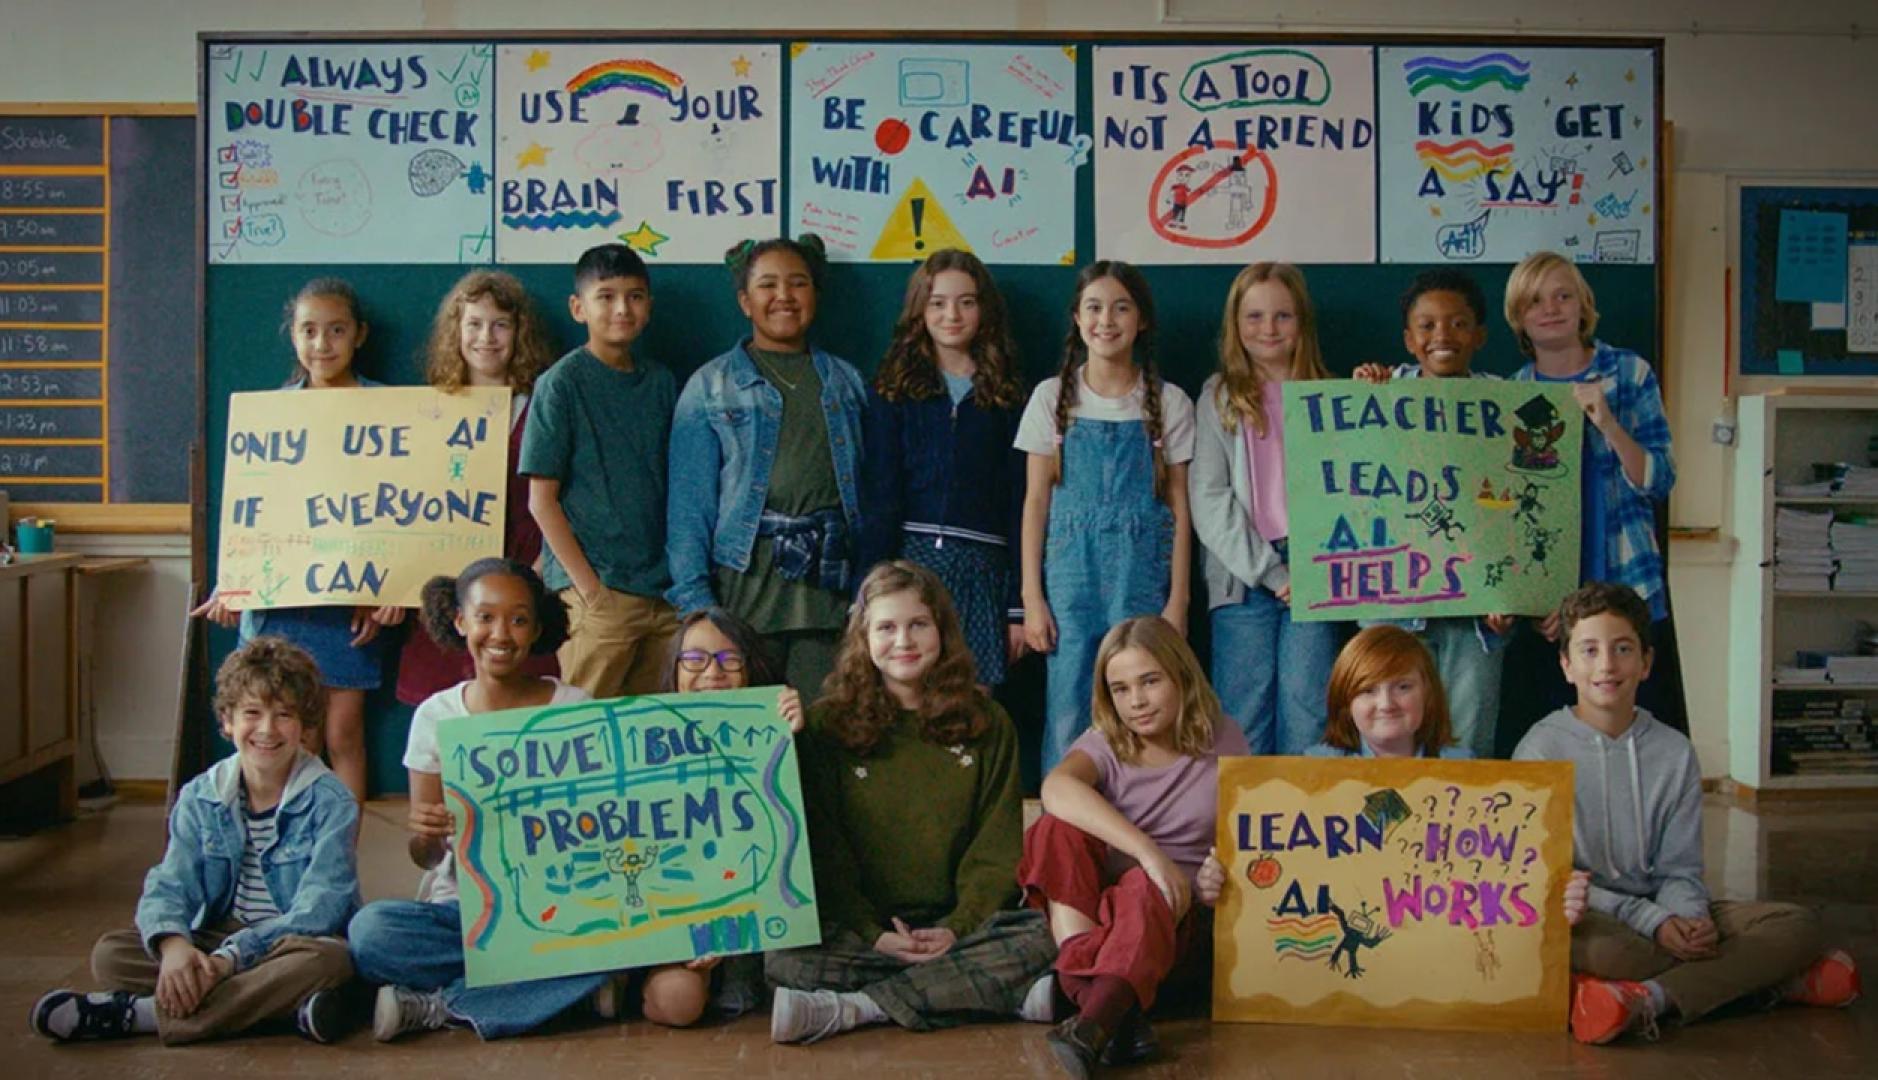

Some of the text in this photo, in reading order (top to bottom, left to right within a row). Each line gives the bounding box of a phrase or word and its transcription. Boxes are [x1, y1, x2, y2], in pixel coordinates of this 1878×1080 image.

[281, 54, 428, 93] ALWAYS
[1113, 63, 1310, 104] ITS A TOOL
[225, 99, 479, 146] DOUBLE CHECK
[521, 85, 763, 124] USE YOUR
[823, 96, 1075, 149] BE CAREFUL
[1555, 104, 1624, 139] GET
[1104, 114, 1373, 150] NOT A FRIEND
[2, 179, 45, 199] 8:55
[503, 178, 777, 216] BRAIN FIRST
[812, 155, 1016, 200] WITH AI
[1418, 166, 1446, 197] A
[0, 259, 39, 277] 0:05
[2, 334, 48, 354] 11:58
[0, 373, 41, 394] 2:53
[1299, 392, 1506, 439] TEACHER
[230, 416, 487, 465] ONLY USE AI
[1321, 460, 1463, 504] LEADS
[233, 482, 497, 528] IF EVERYONE
[305, 560, 389, 598] CAN
[1330, 551, 1466, 599] HELPS
[469, 719, 712, 788] SOLVE BIG
[522, 786, 756, 856] PROBLEMS
[1238, 810, 1519, 863] LEARN HOW
[1382, 874, 1539, 930] WORKS
